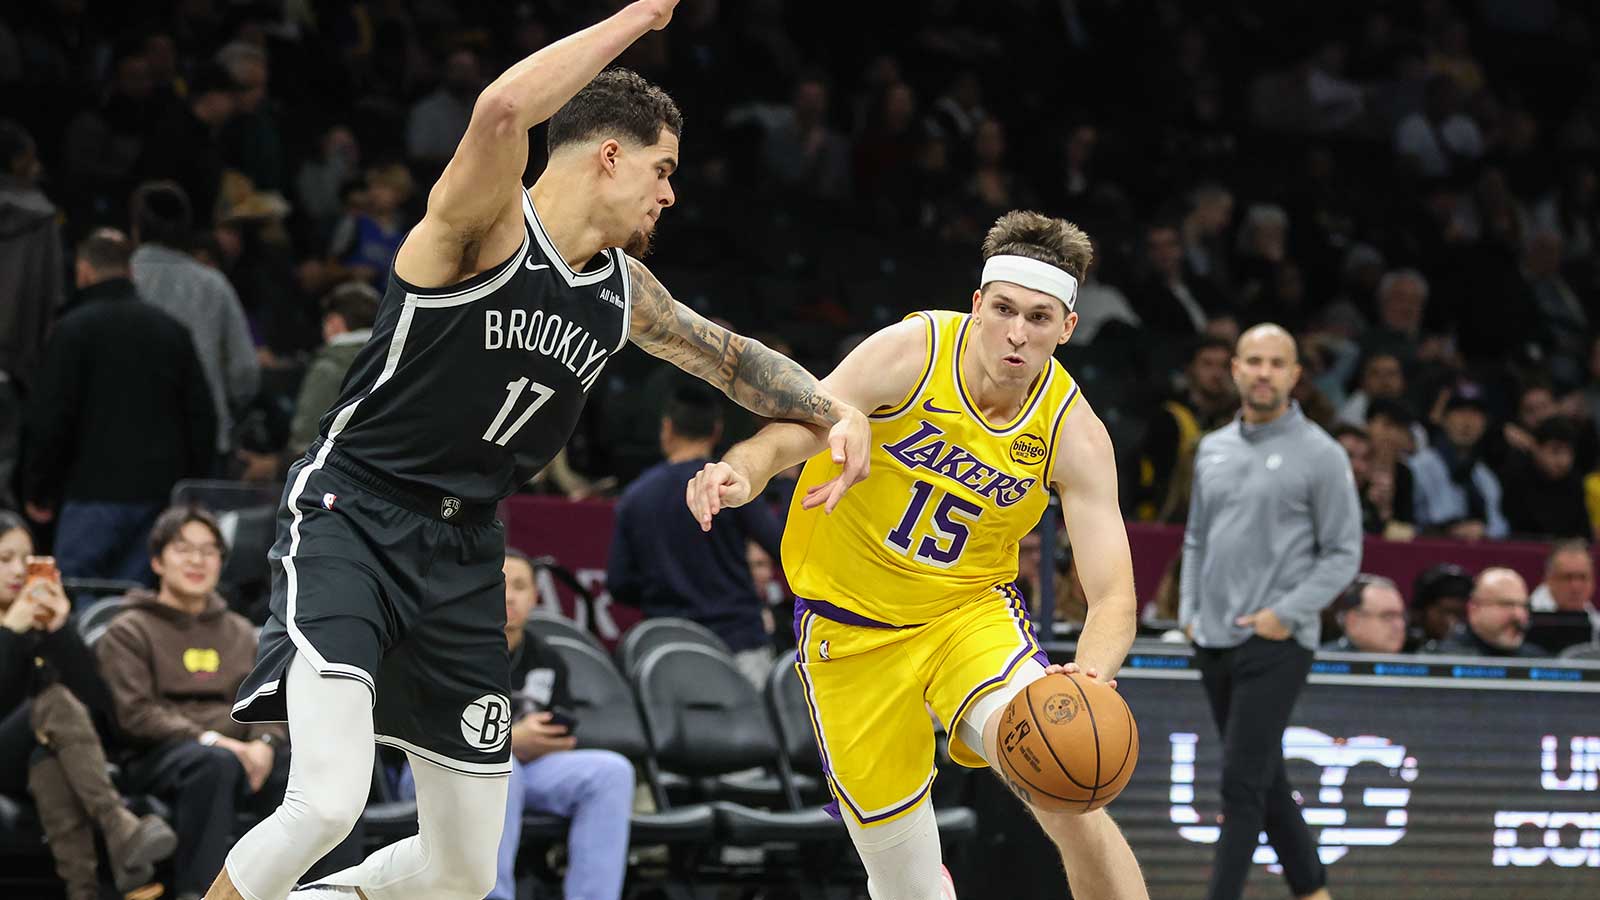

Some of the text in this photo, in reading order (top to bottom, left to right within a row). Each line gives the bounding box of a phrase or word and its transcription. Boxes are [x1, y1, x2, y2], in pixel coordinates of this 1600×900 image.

[600, 288, 610, 301] All
[482, 376, 556, 447] 17
[881, 420, 1038, 508] LAKERS
[1012, 440, 1045, 458] bibigo
[443, 499, 460, 510] NETS
[884, 480, 984, 569] 15
[479, 701, 502, 745] B
